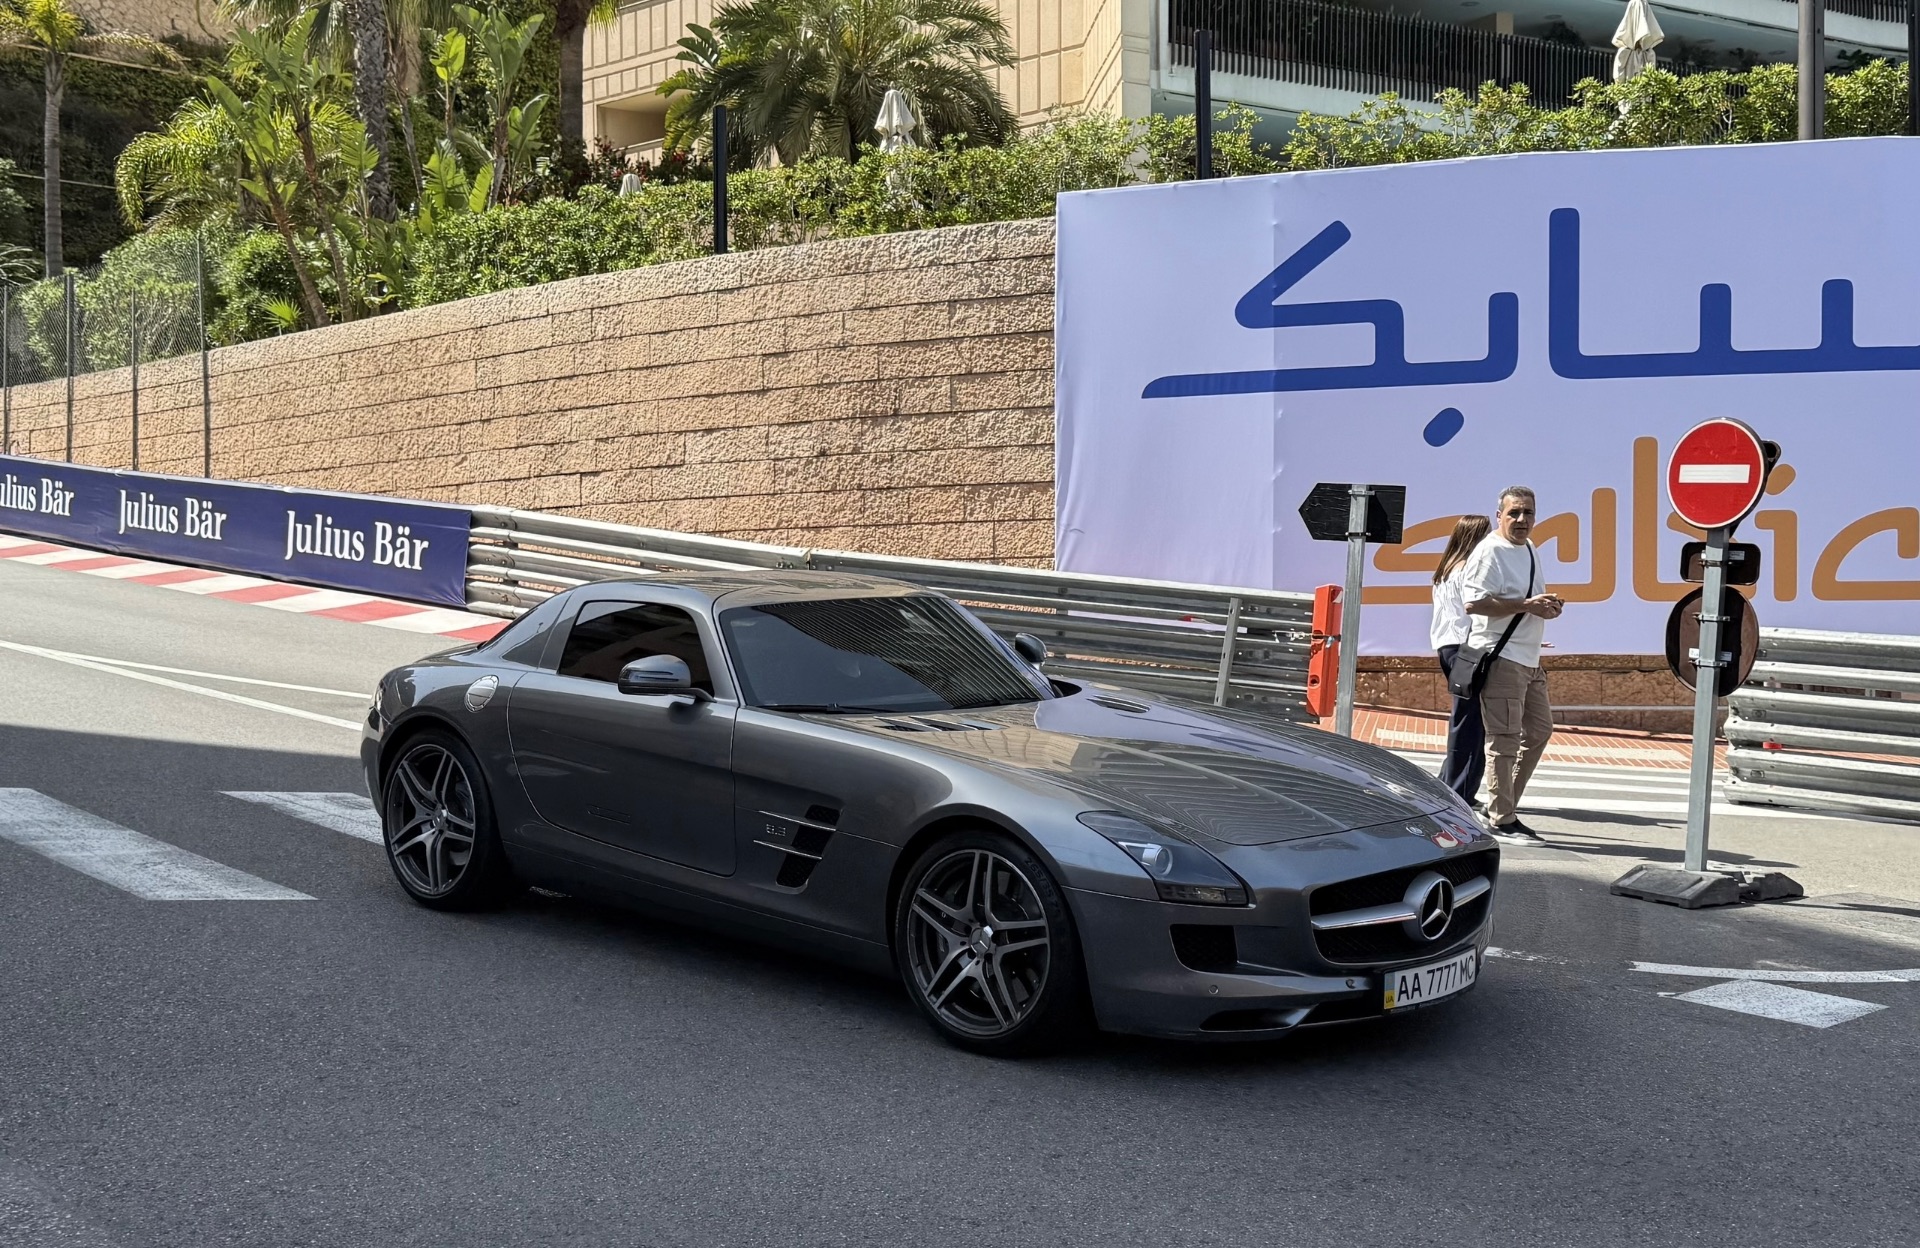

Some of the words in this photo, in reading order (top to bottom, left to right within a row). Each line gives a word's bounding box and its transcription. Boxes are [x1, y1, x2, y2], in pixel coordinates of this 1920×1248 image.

[0, 474, 36, 512] lius
[40, 478, 75, 516] Bär
[118, 489, 179, 535] Julius
[184, 497, 227, 541] Bär
[284, 510, 365, 561] Julius
[372, 522, 429, 571] Bär
[766, 823, 786, 837] 6.3
[1385, 995, 1394, 1004] UA
[1397, 973, 1422, 1002] AA
[1427, 962, 1457, 995] 7777
[1460, 955, 1474, 984] MC
